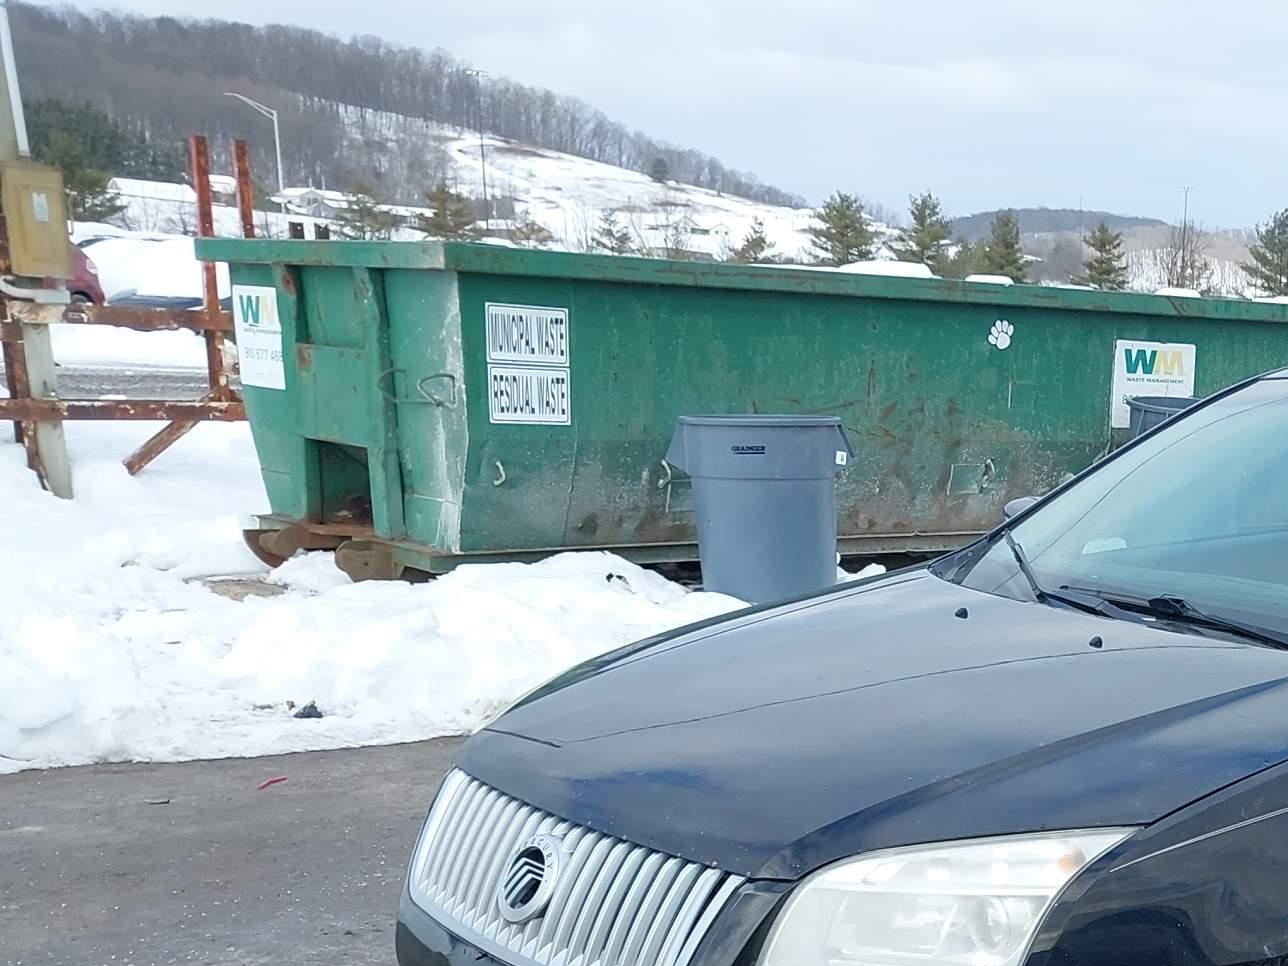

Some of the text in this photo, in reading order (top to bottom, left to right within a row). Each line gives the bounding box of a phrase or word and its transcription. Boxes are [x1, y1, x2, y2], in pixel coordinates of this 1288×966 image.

[490, 312, 565, 357] MUNICIPAL WASTE
[1124, 349, 1185, 377] WM
[493, 374, 566, 416] RESIDUAL WASTE
